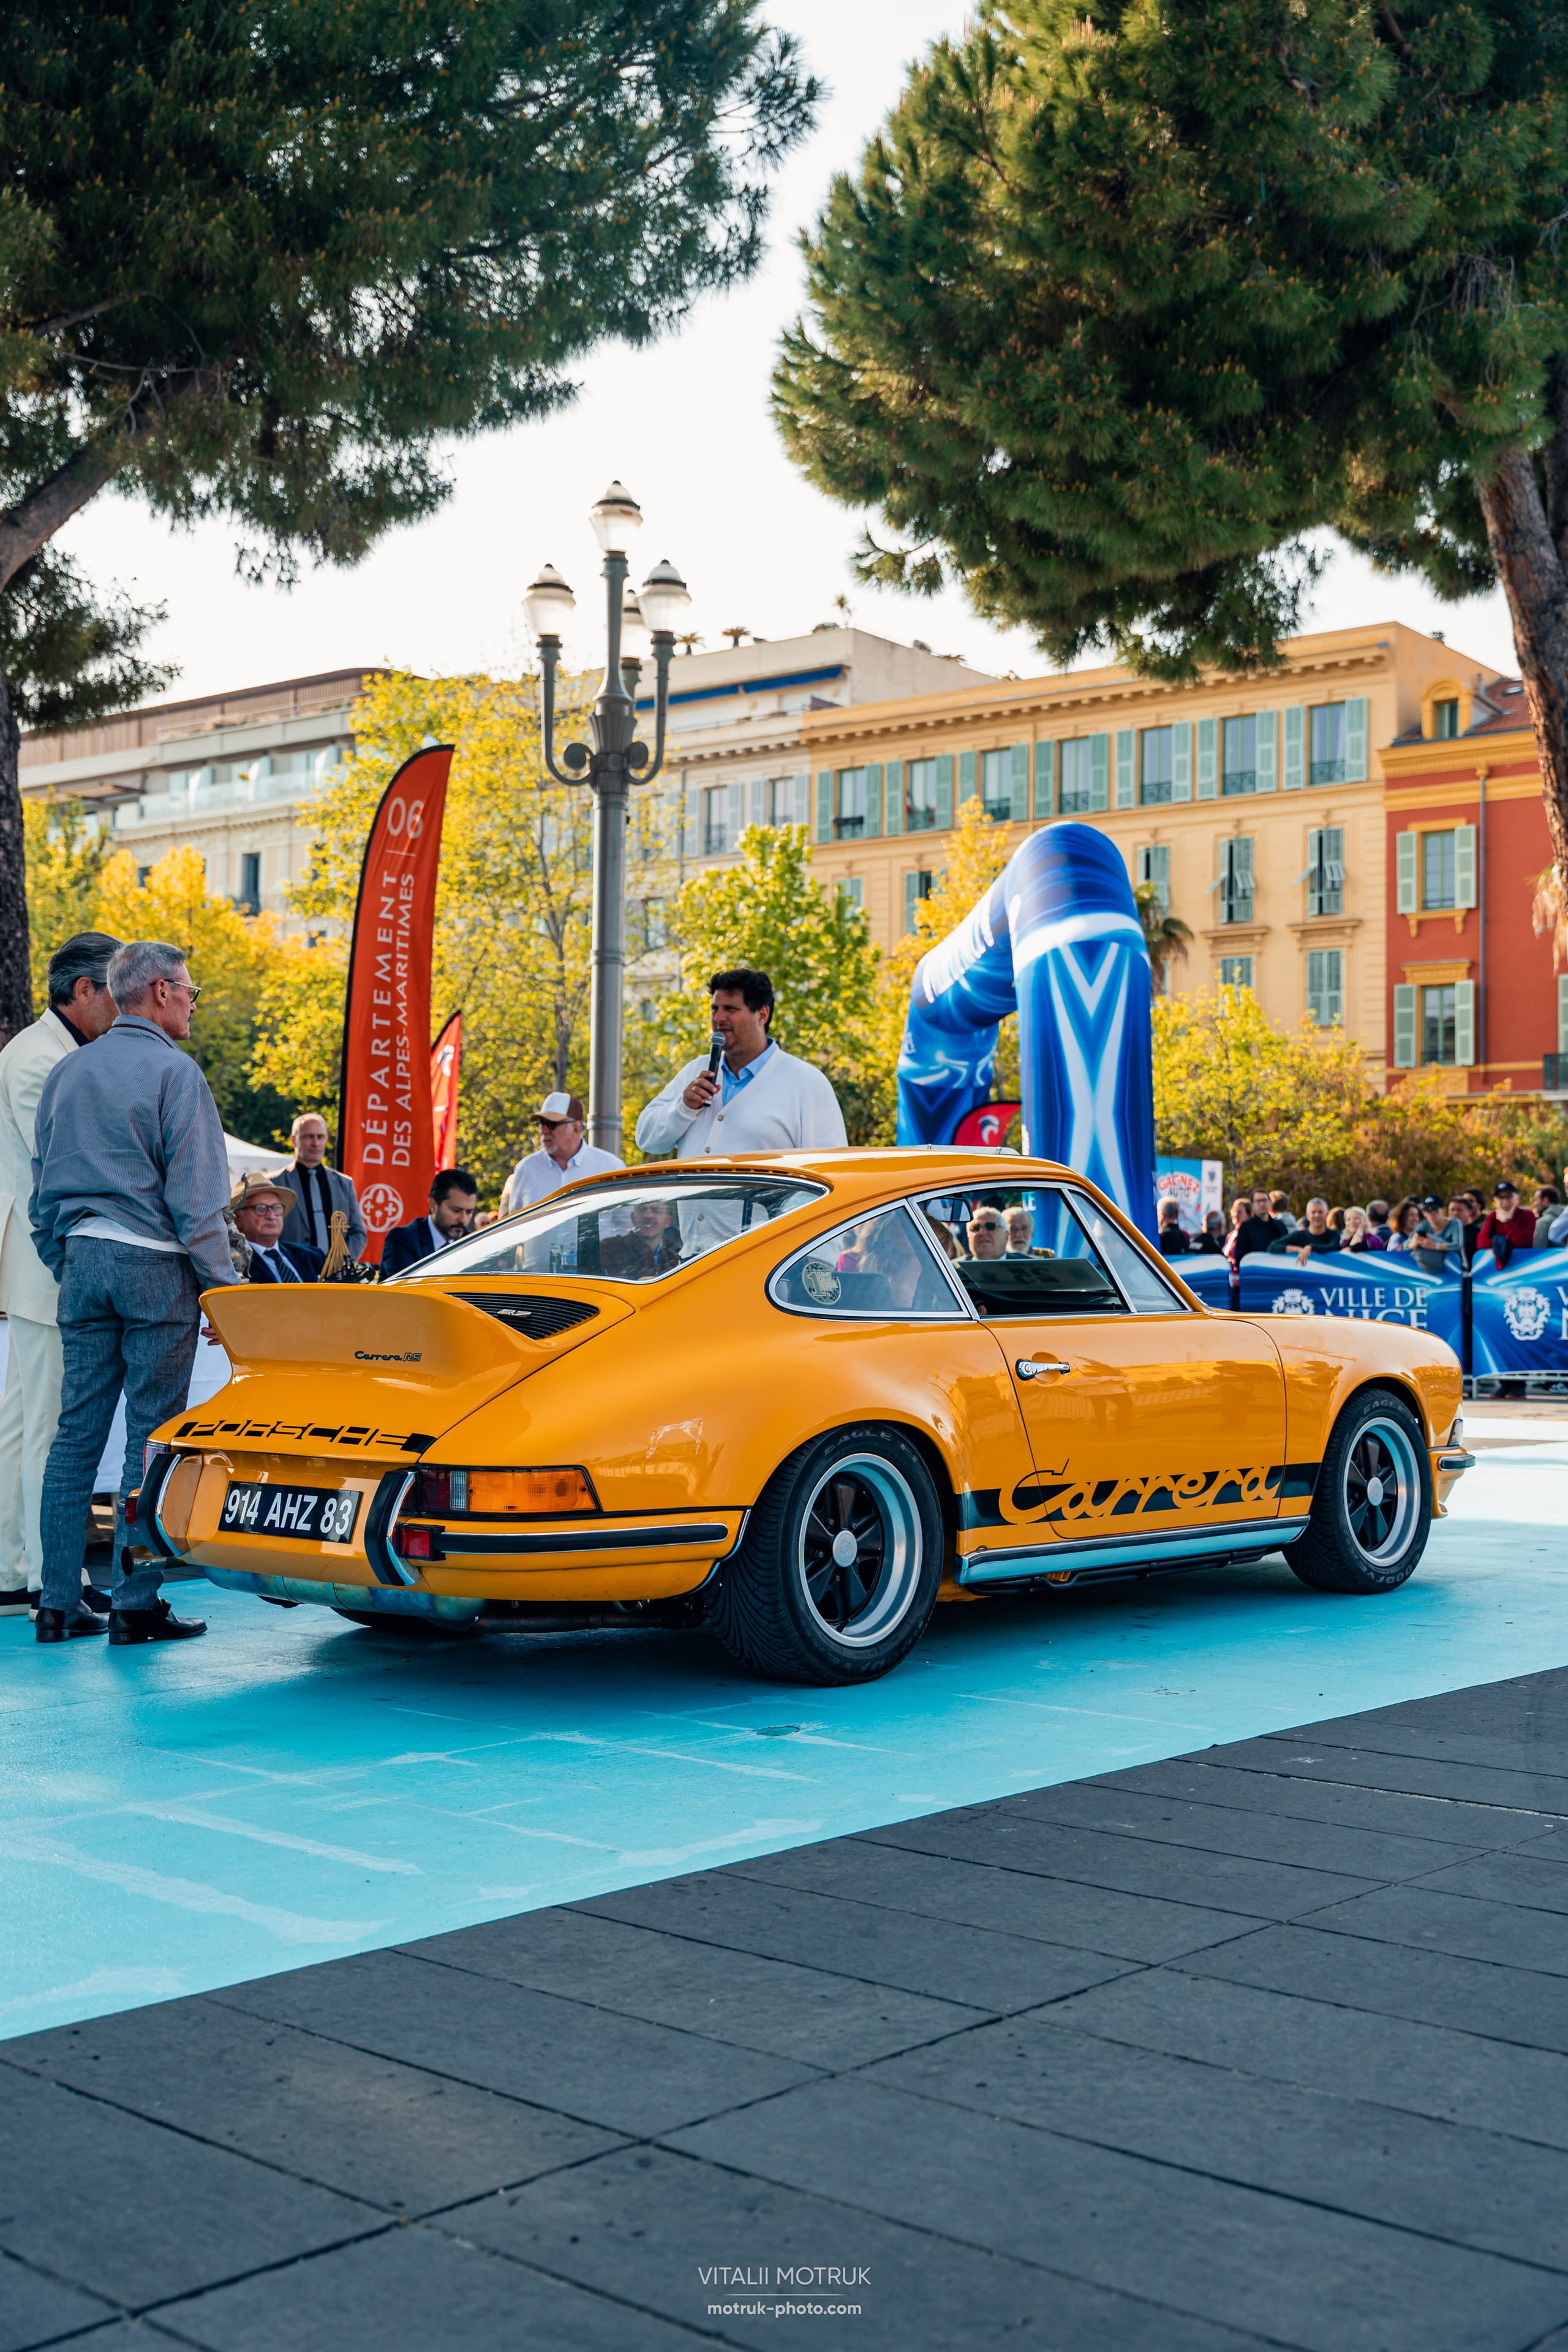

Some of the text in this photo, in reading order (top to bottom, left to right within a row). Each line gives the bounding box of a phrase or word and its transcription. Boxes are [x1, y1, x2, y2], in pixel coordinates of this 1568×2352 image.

[387, 797, 424, 839] 06
[362, 870, 397, 1166] DÉPARTEMENT
[391, 873, 415, 1167] DES ALPES-MARITIMES
[1319, 1287, 1428, 1307] VILLE DE
[354, 1350, 423, 1362] Carrera RS
[183, 1419, 414, 1450] PORSCHE
[824, 1429, 892, 1456] EAGLE
[224, 1488, 353, 1536] 914 AHZ 83
[998, 1458, 1283, 1525] Carrera
